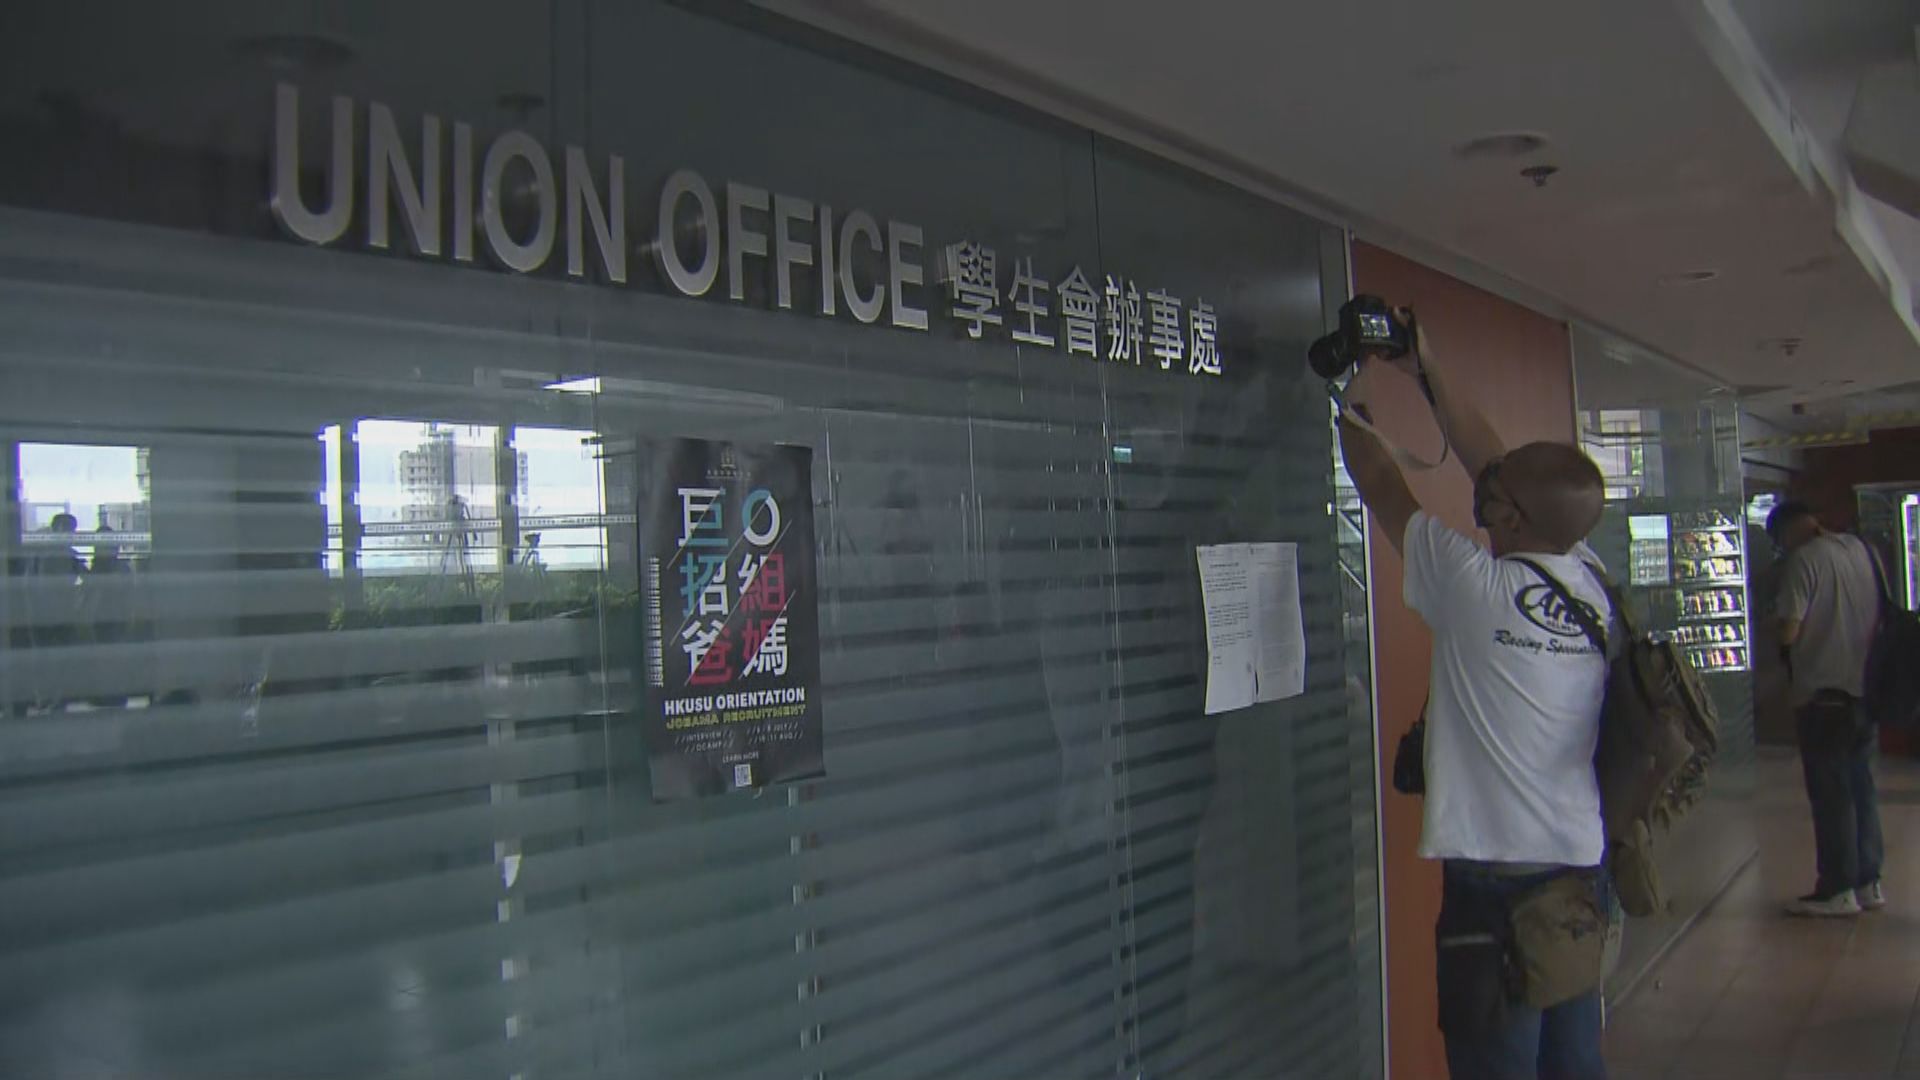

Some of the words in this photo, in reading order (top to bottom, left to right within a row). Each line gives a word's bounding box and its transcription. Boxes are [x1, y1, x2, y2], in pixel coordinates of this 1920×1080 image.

[273, 82, 626, 283] UNION
[657, 169, 928, 330] OFFICE
[946, 240, 1222, 376] 學生會辦事處
[664, 696, 712, 716] HKUSU
[716, 687, 805, 709] ORIENTATION
[666, 713, 719, 730] JOBAMA
[723, 704, 806, 724] RECRUITMENT
